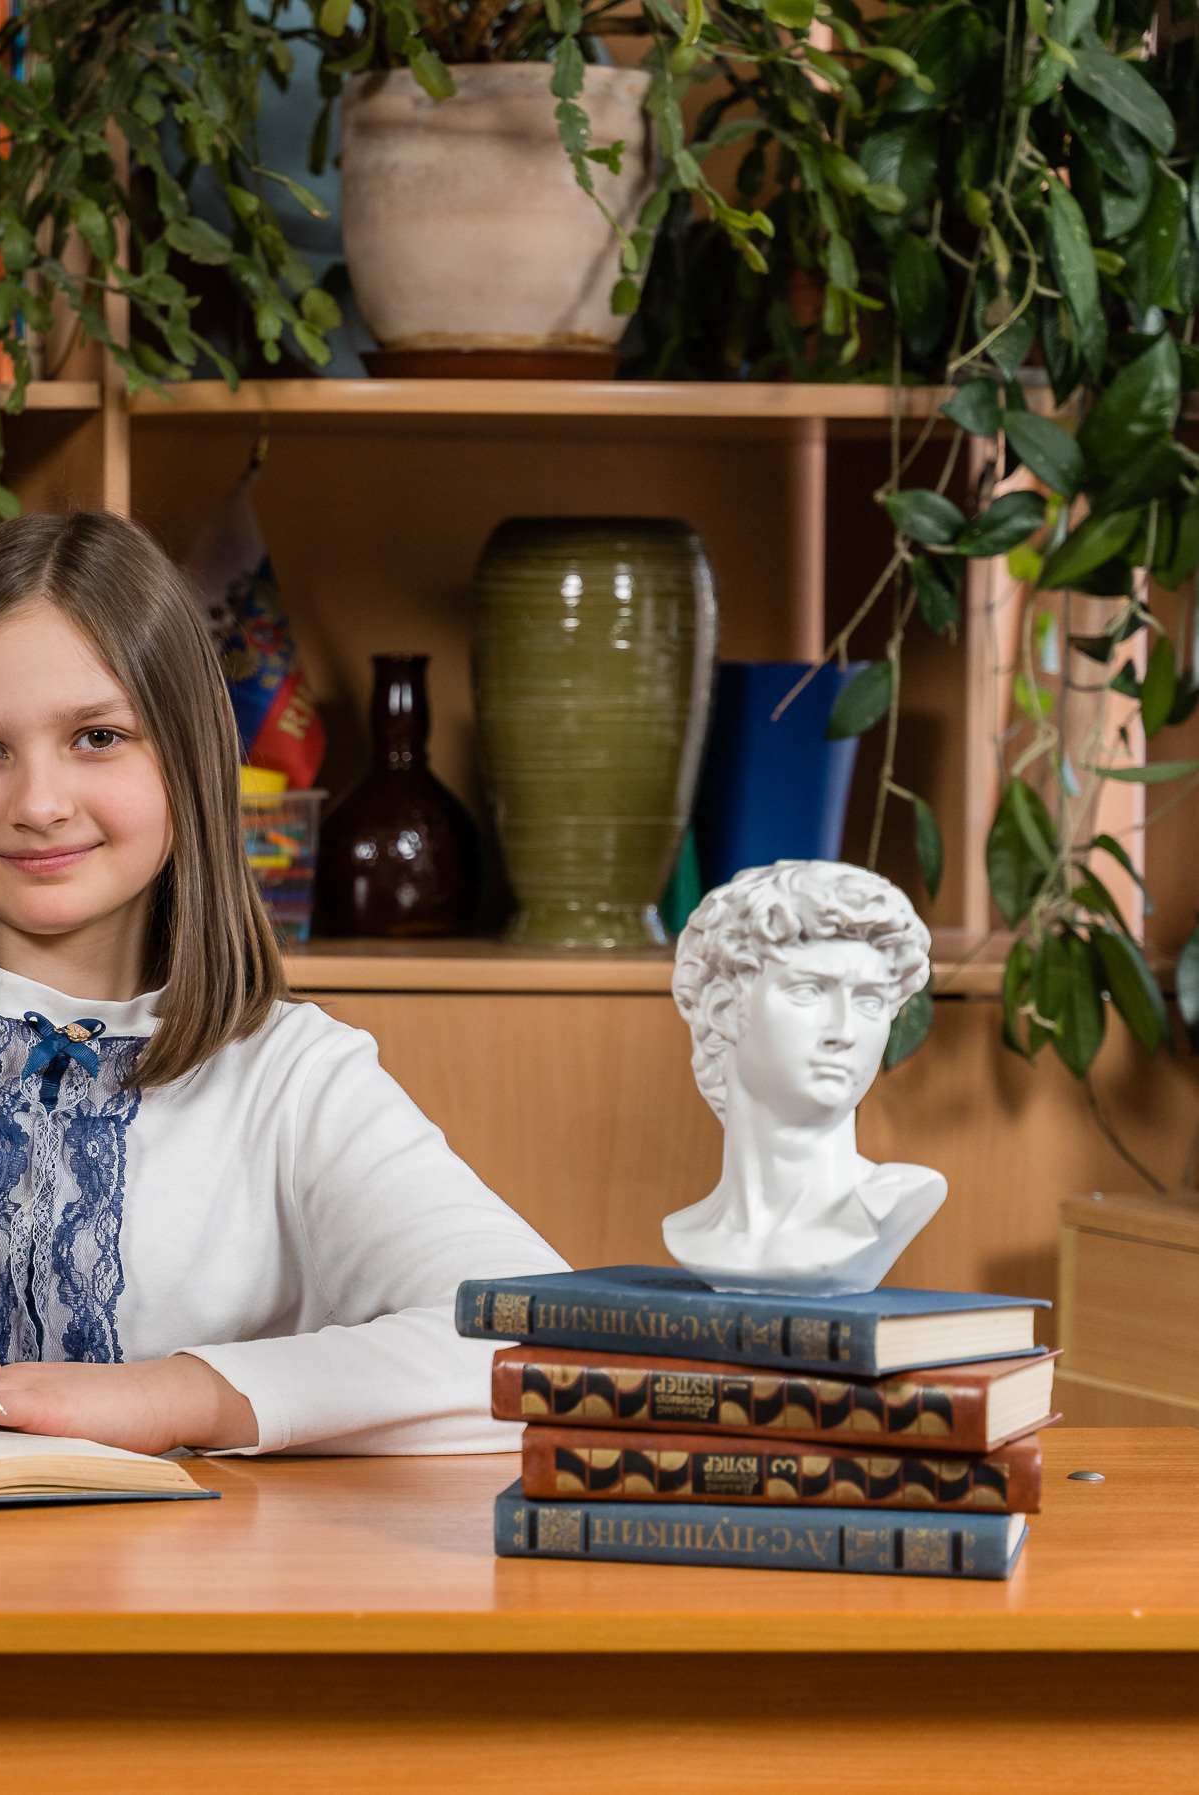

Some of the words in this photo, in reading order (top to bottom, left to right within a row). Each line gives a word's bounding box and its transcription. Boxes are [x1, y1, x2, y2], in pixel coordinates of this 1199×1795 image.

[537, 1303, 670, 1340] ПУШКИН
[654, 1376, 714, 1396] КУПЕР
[703, 1456, 758, 1474] КУПЕР
[592, 1516, 755, 1555] ПУШКИН
